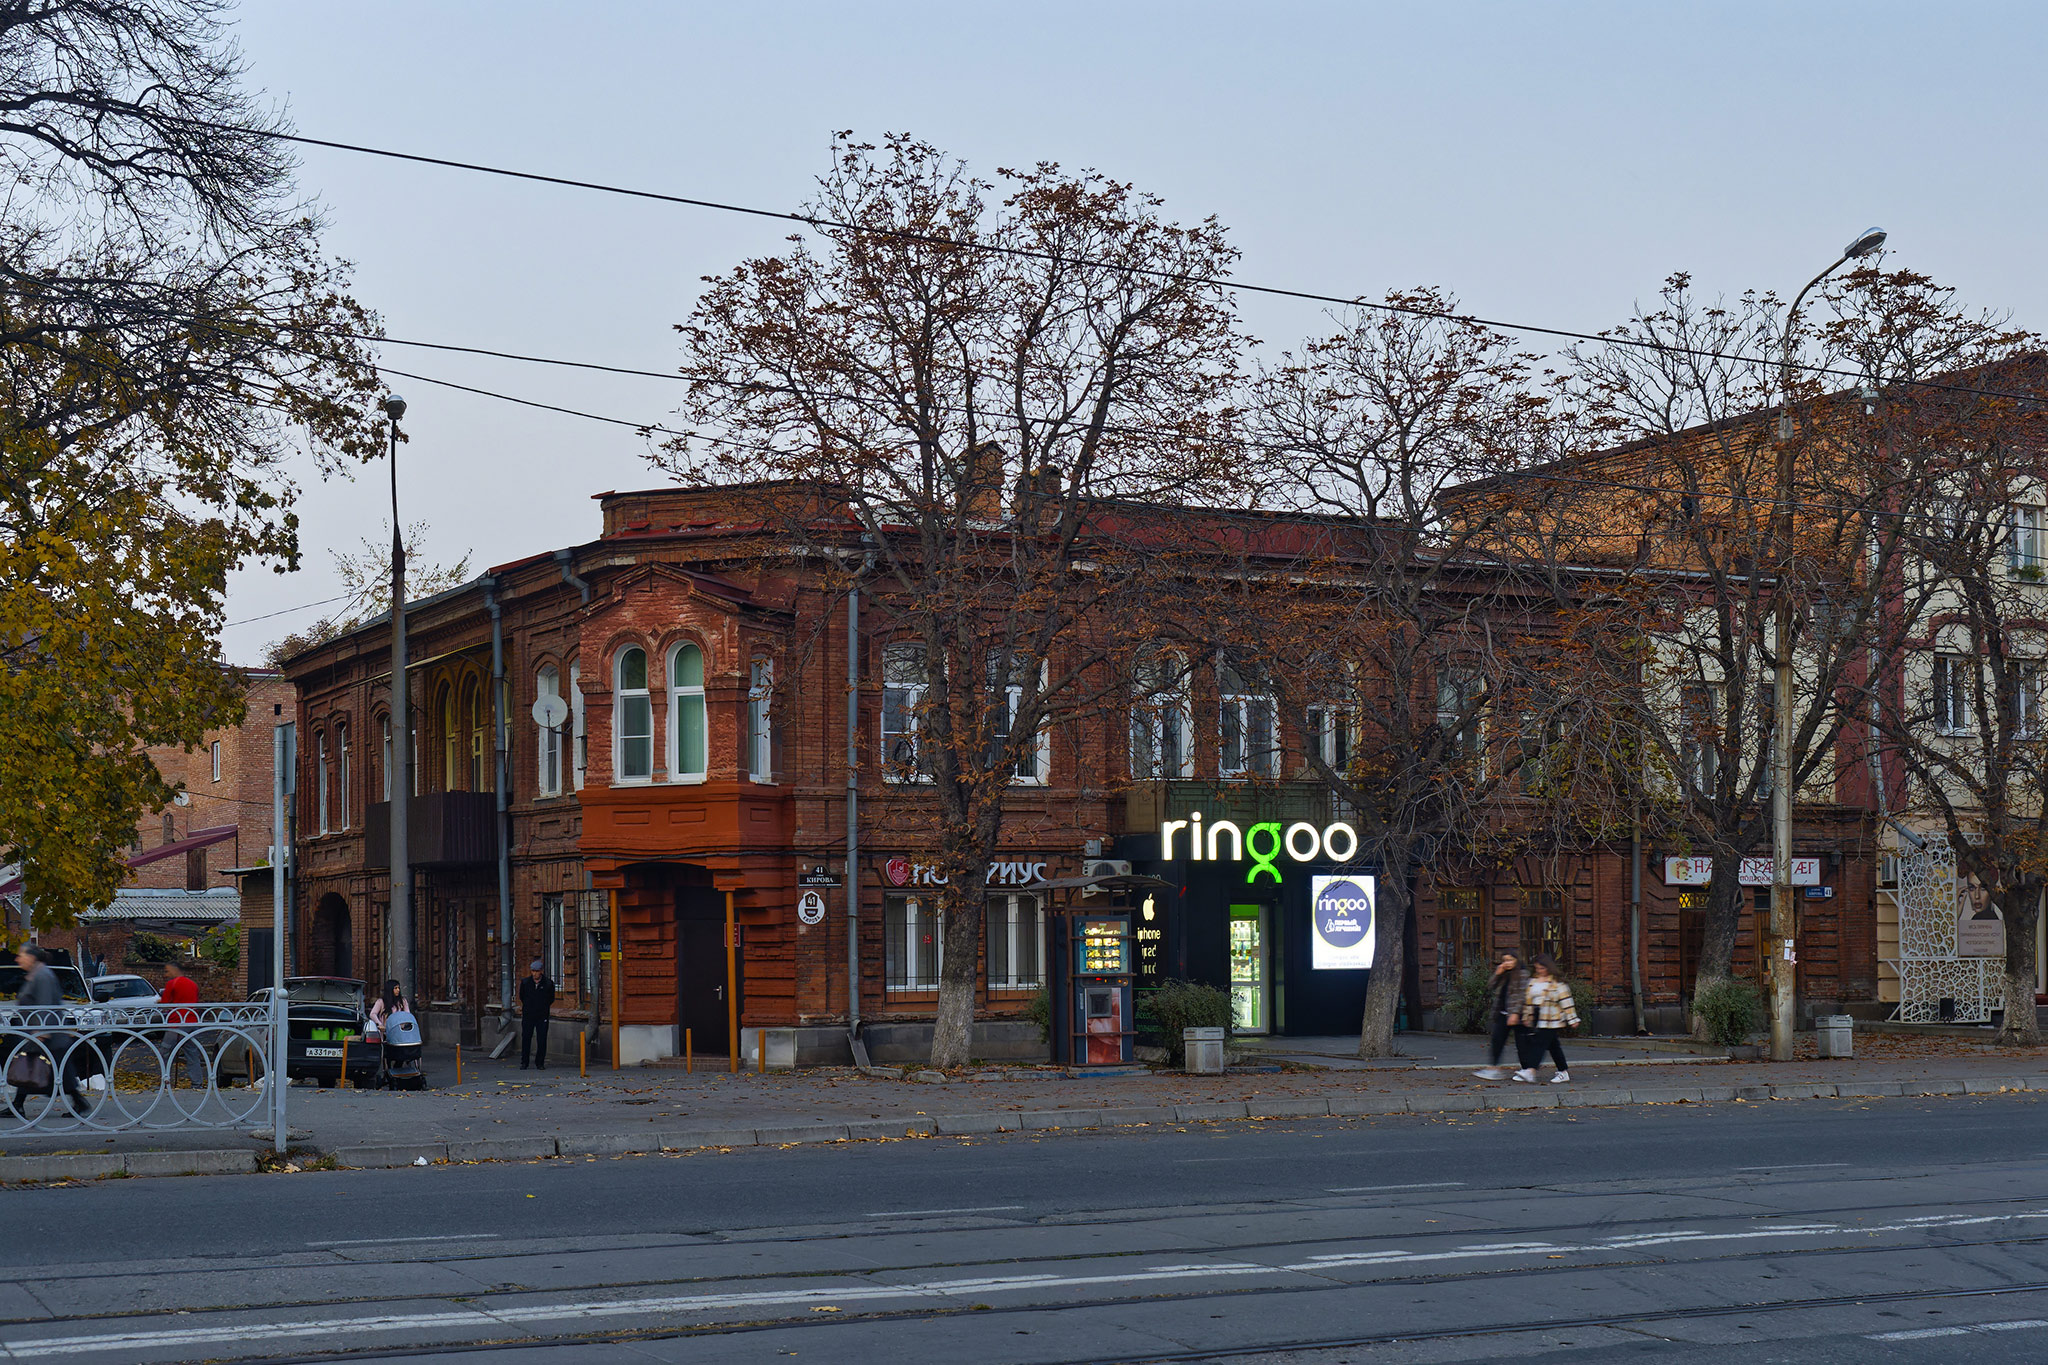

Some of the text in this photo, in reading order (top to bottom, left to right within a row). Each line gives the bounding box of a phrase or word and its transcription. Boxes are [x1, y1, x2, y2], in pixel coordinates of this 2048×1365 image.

[1161, 811, 1358, 883] ringoo
[808, 896, 816, 906] 41
[1318, 895, 1367, 916] ringoo
